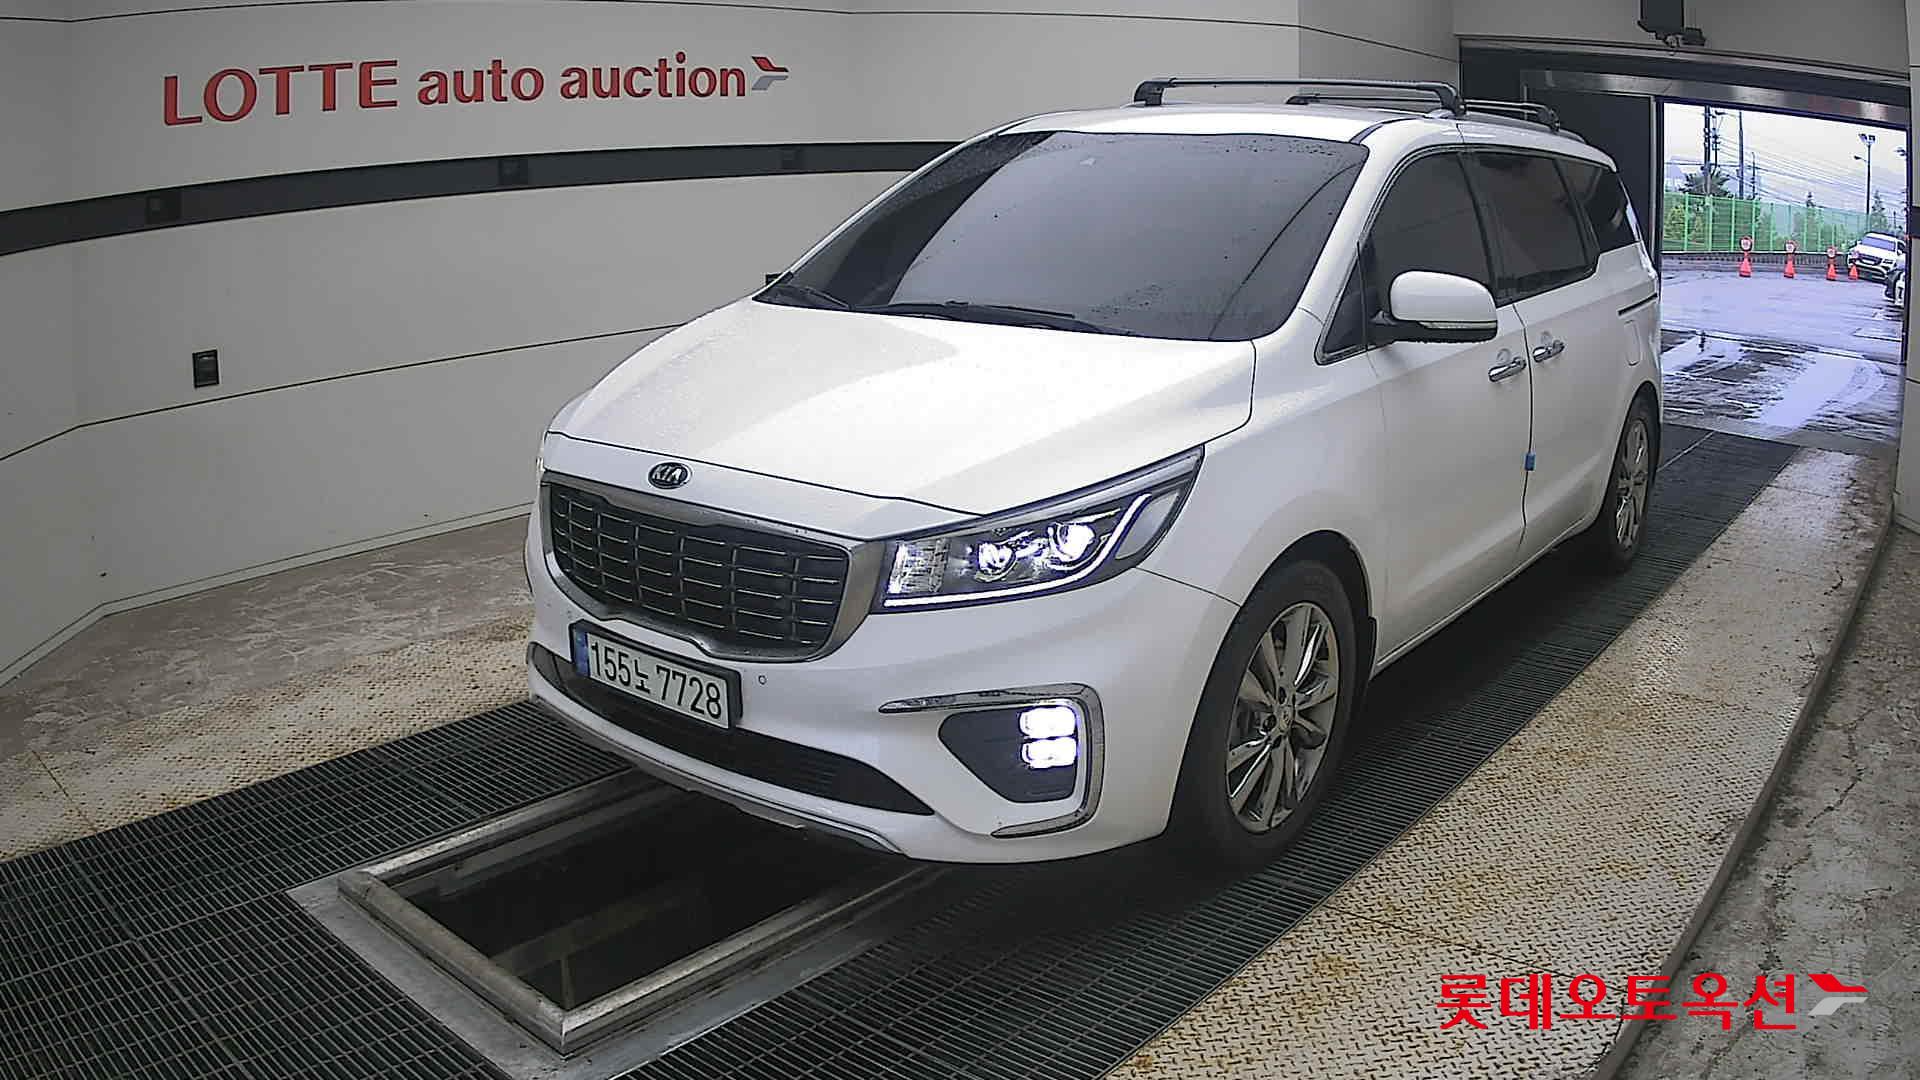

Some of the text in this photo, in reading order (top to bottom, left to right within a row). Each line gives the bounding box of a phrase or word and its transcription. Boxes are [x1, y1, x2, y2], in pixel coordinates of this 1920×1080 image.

[164, 51, 747, 126] LOTTE auto auction
[651, 464, 683, 484] KIA
[655, 664, 722, 720] 7728
